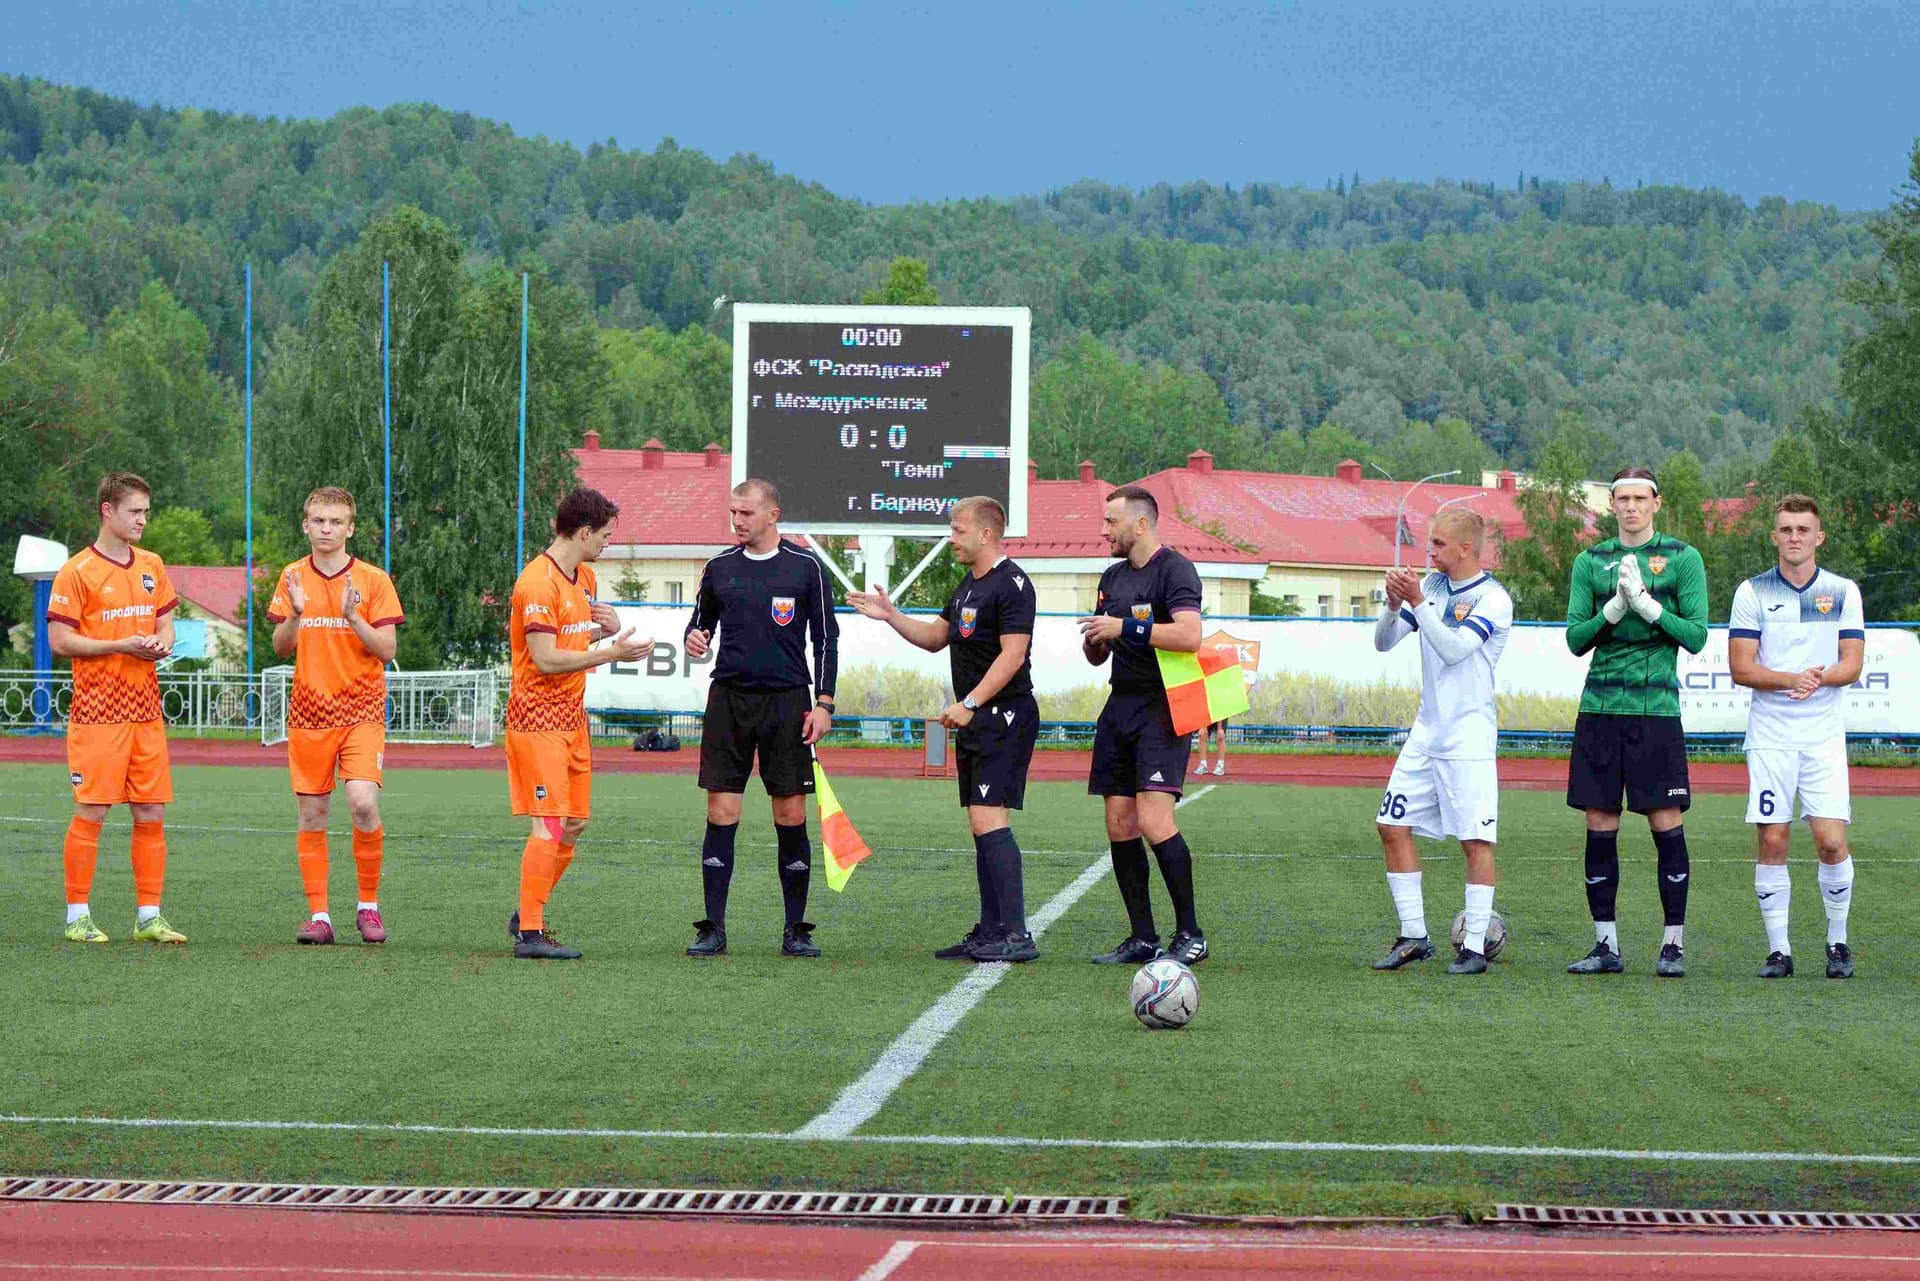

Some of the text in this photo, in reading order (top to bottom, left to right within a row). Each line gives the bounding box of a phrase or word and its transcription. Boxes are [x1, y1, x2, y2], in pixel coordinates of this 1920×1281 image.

[841, 328, 902, 346] 00:00
[753, 358, 803, 377] ФСК
[881, 460, 953, 478] "Темп"
[848, 495, 862, 510] г.
[1759, 789, 1776, 816] 6
